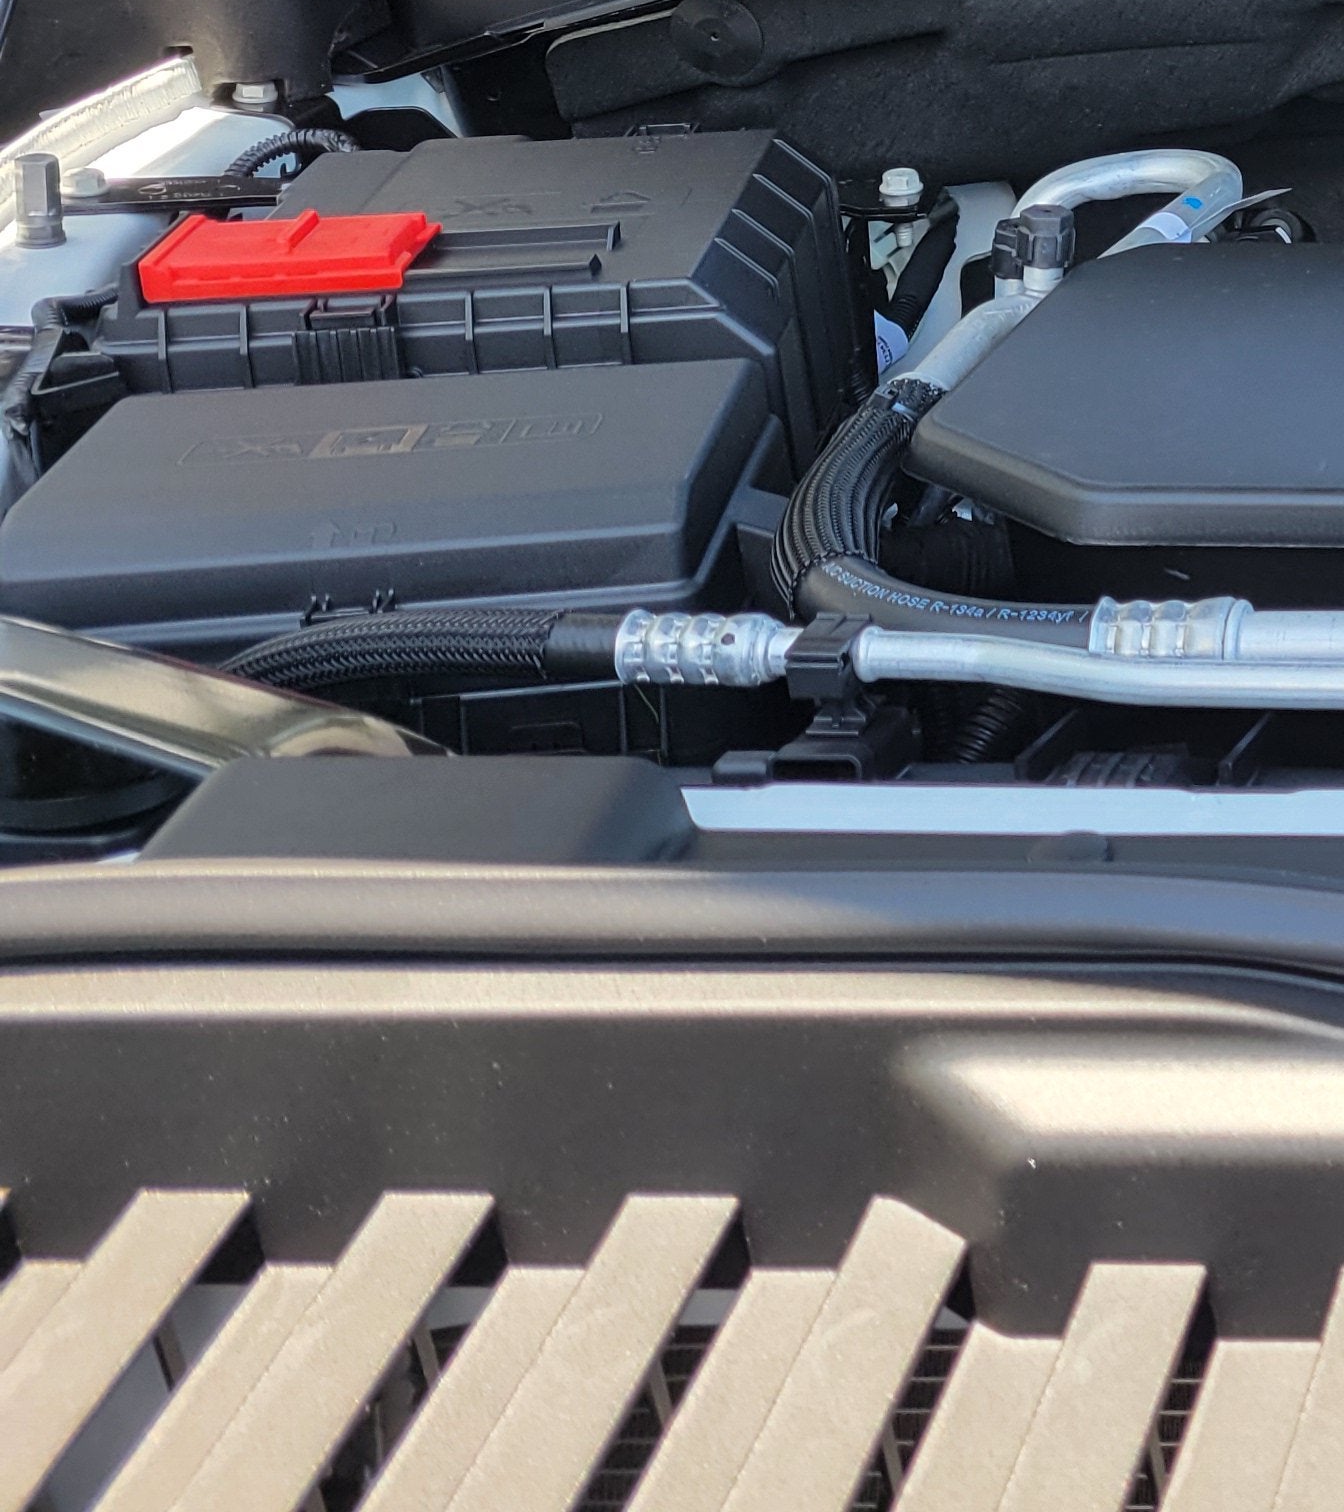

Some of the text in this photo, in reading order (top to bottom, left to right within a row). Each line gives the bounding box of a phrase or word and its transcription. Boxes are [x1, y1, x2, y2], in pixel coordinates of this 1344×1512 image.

[837, 571, 890, 600] SUCTION
[886, 591, 930, 610] HOSE
[929, 600, 983, 618] R-134a
[997, 607, 1075, 624] R-1234yf
